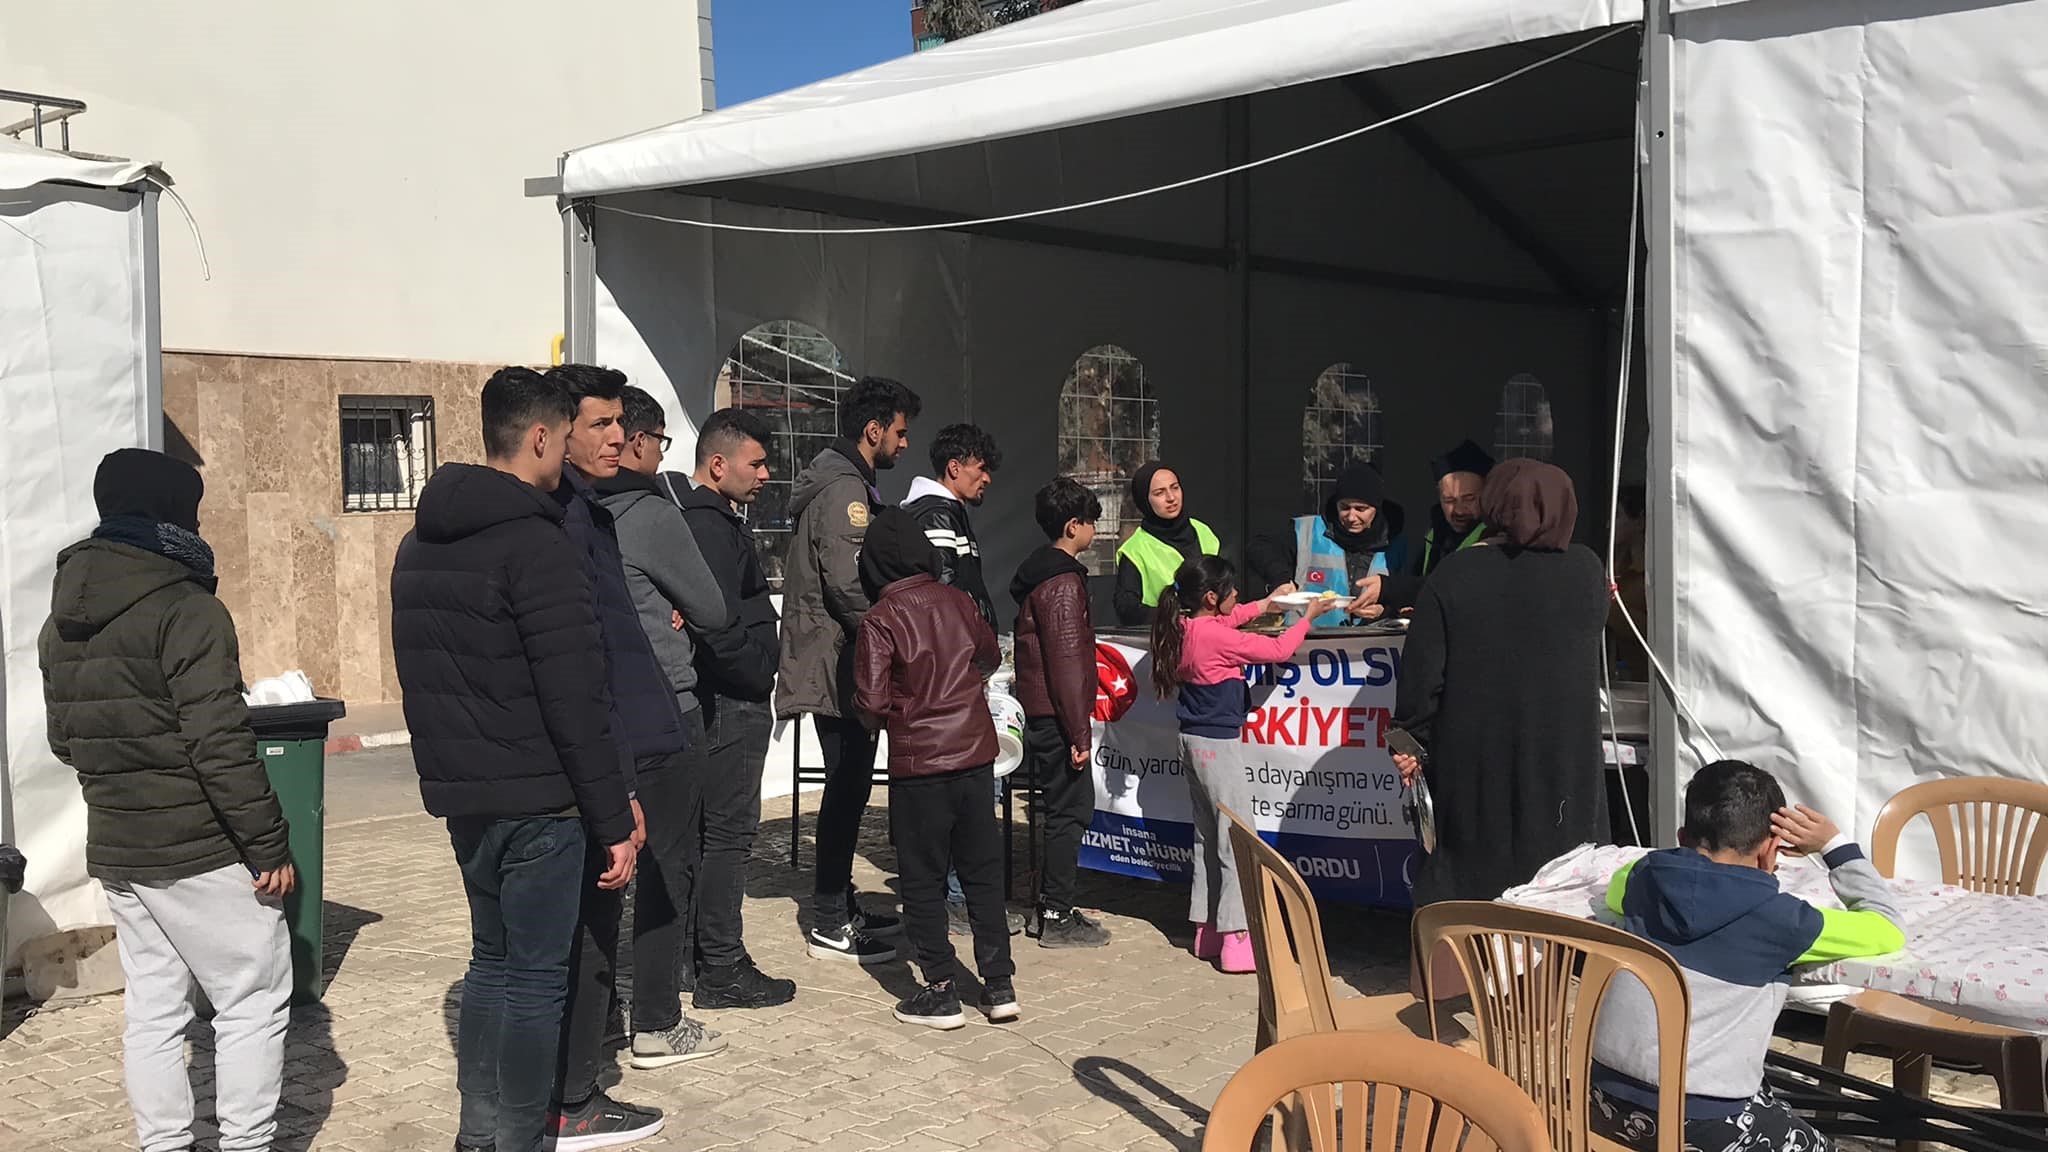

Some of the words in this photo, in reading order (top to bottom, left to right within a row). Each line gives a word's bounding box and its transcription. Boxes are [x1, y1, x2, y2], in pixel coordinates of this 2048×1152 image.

[1095, 745, 1136, 775] Gün,
[1258, 761, 1367, 795] dayanışma
[1372, 772, 1394, 791] ve
[1251, 796, 1271, 816] te
[1274, 801, 1335, 822] sarma
[1336, 801, 1393, 830] günü.
[1110, 854, 1130, 864] eden
[1132, 845, 1146, 856] ve
[1296, 856, 1360, 880] ORDU
